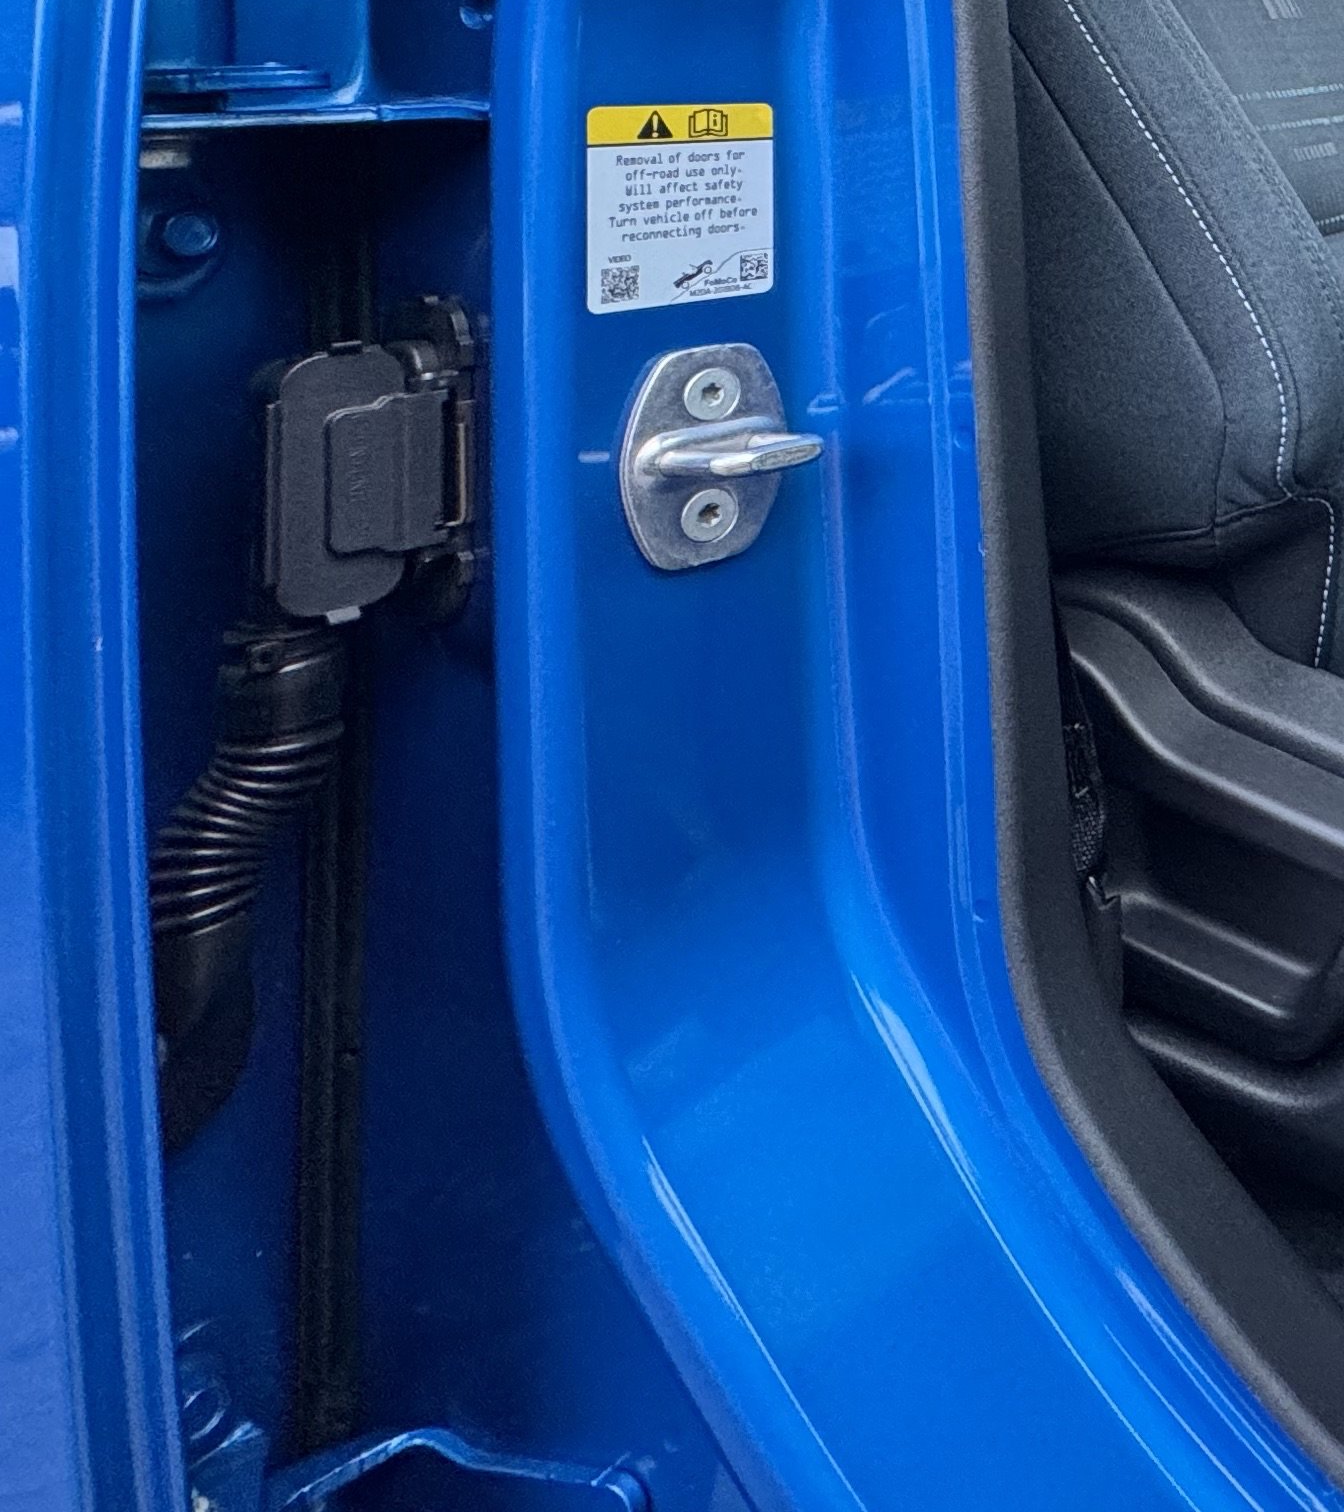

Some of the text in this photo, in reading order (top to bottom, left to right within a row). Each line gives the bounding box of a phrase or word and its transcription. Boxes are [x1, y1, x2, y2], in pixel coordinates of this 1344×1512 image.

[616, 150, 746, 166] Removal of doors for
[625, 167, 680, 181] off-road
[685, 167, 705, 177] use
[625, 178, 743, 196] Will affect safety
[618, 199, 660, 214] system
[608, 205, 758, 228] Turn vehicle off before
[621, 225, 702, 243] reconnecting
